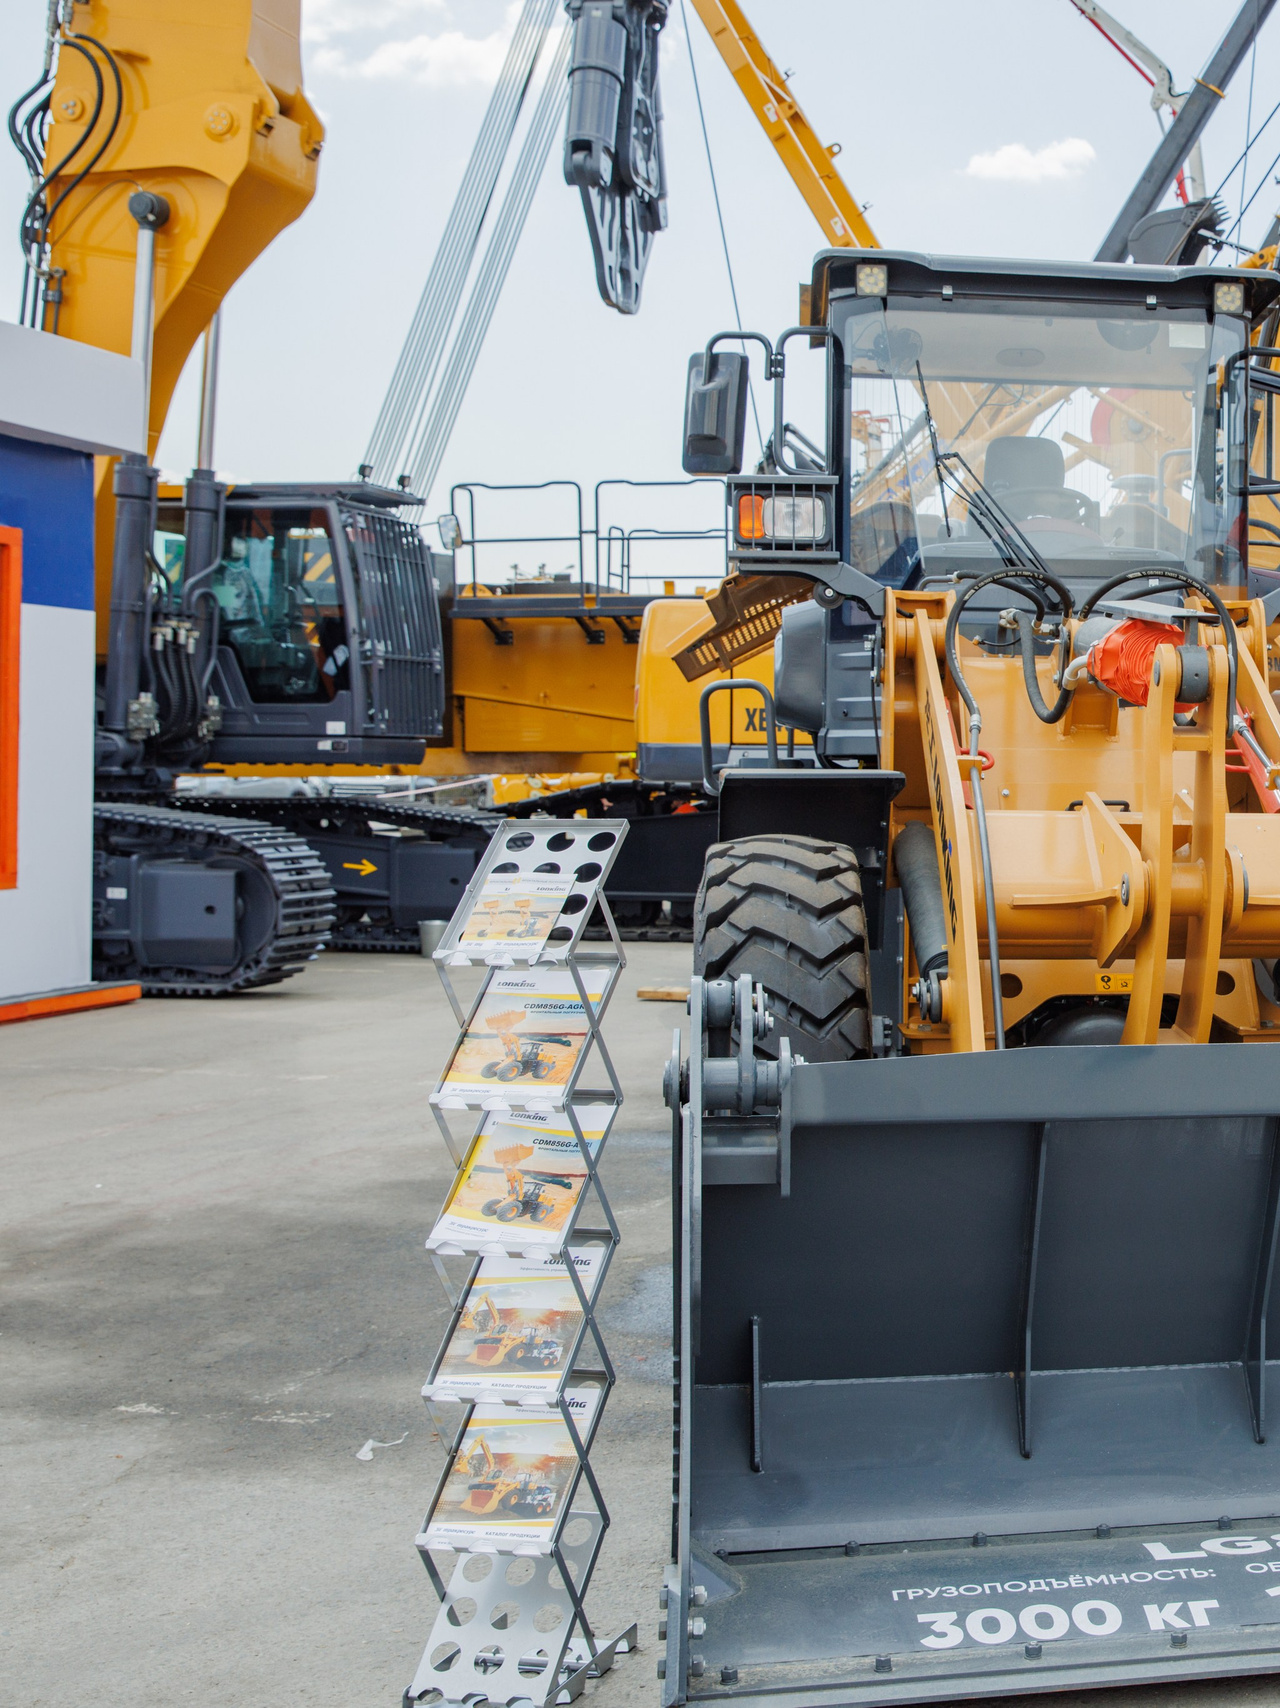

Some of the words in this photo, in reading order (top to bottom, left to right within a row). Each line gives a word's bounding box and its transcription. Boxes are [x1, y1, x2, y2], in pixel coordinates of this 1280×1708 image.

[532, 1138, 593, 1148] CDM856G-ARI
[543, 1256, 592, 1266] LONING
[892, 1566, 1217, 1602] ГРУЗОПОДЪЁМНОСТЬ:
[917, 1600, 1123, 1649] 3000
